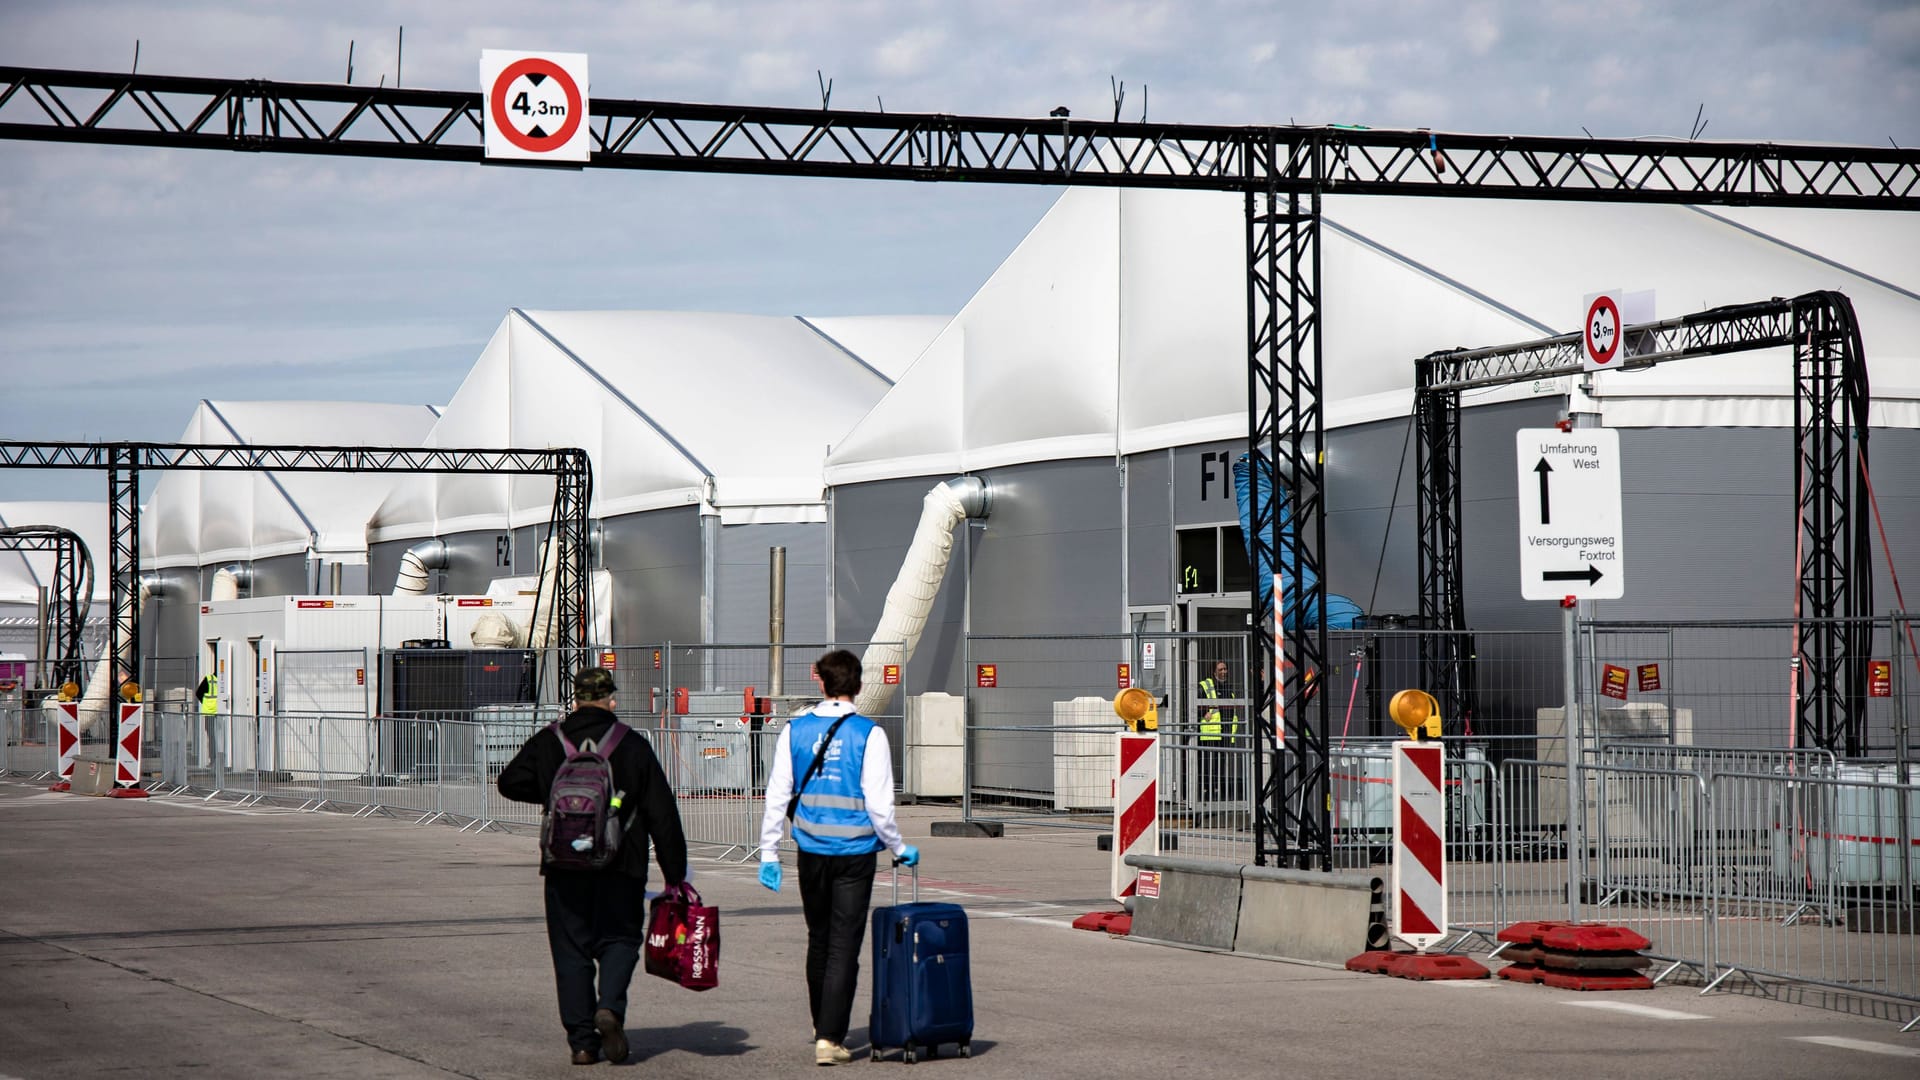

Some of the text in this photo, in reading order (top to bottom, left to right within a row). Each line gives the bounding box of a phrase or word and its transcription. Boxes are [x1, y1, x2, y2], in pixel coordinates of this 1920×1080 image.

[511, 91, 565, 117] 4,3m
[1593, 321, 1614, 339] 3,9m
[1540, 443, 1598, 455] Umfahrung
[1573, 458, 1600, 469] West
[1201, 450, 1230, 501] F1
[496, 535, 510, 567] F2
[1528, 536, 1615, 548] Versorgungsweg
[1579, 550, 1616, 561] Foxtrot
[1185, 565, 1198, 589] F1
[692, 916, 706, 979] ROSSMANN
